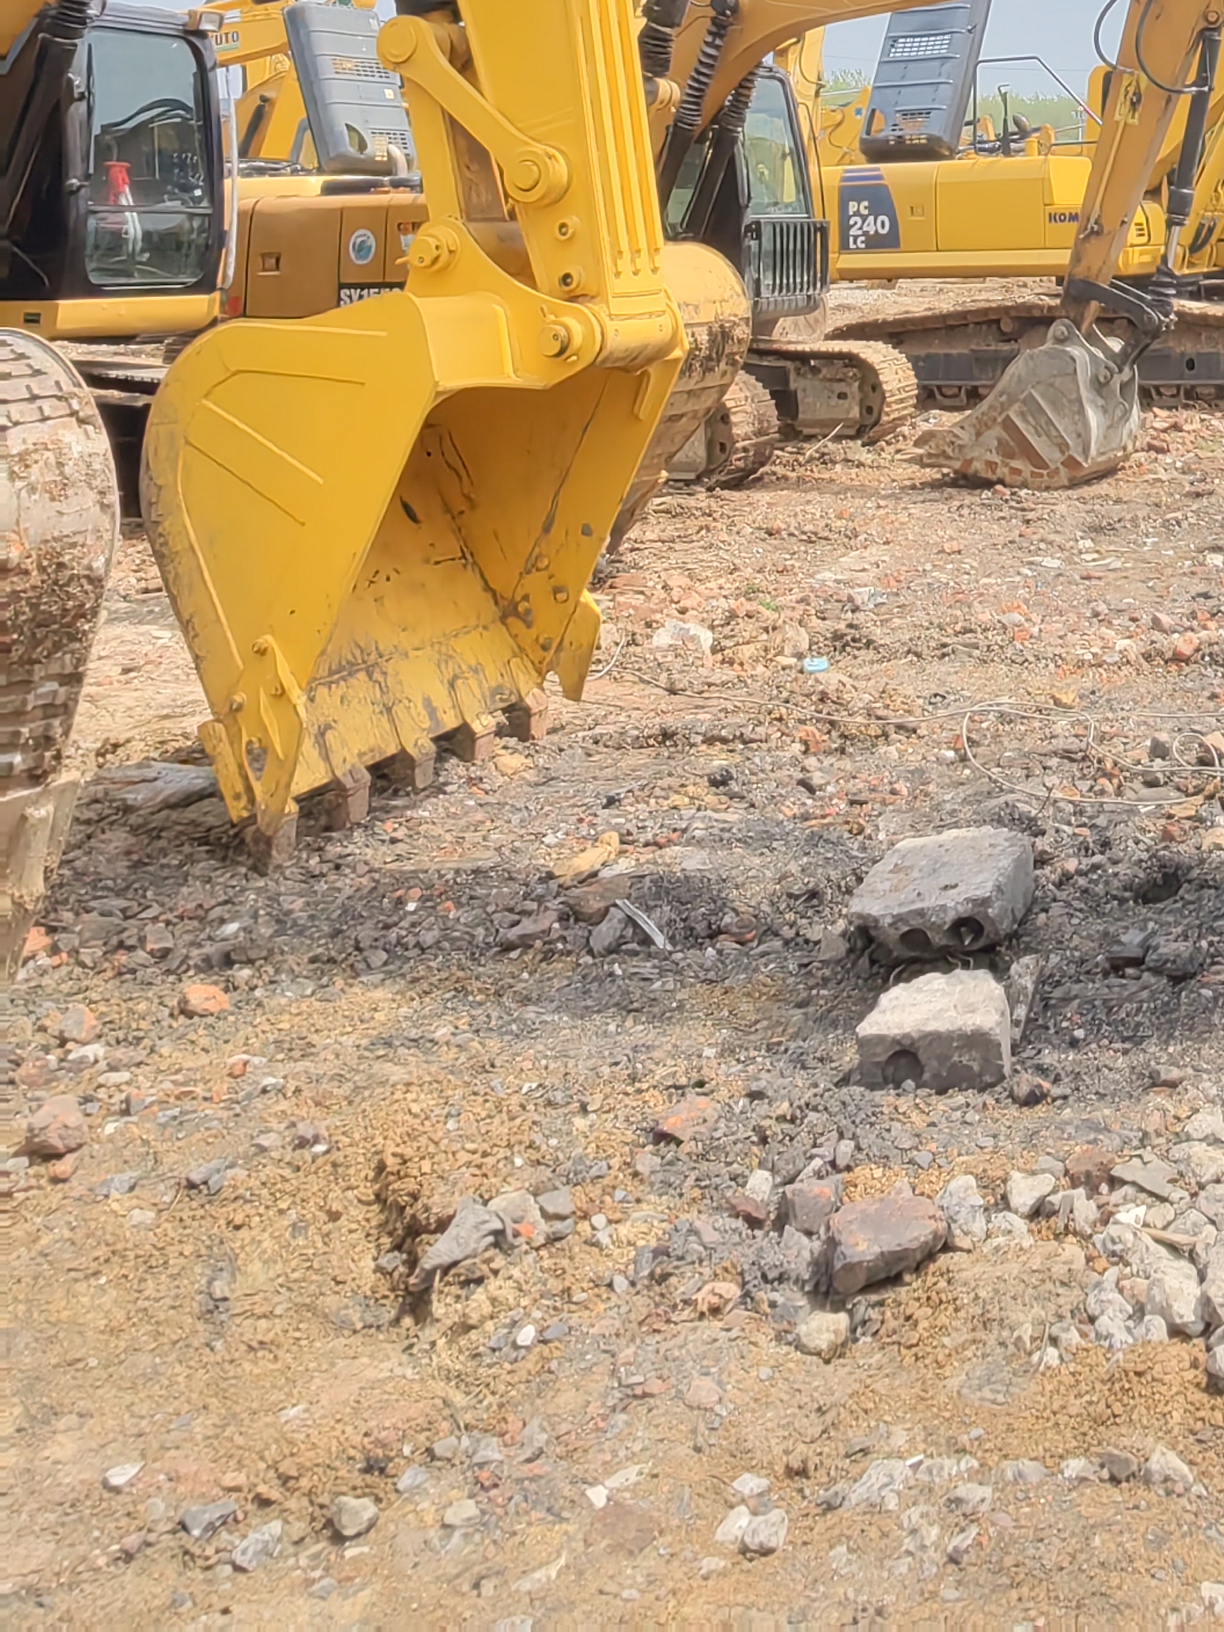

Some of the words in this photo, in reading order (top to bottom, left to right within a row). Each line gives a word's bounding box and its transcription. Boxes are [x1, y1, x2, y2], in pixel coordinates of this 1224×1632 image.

[848, 200, 869, 216] PC
[848, 215, 891, 236] 240
[848, 236, 867, 249] LC
